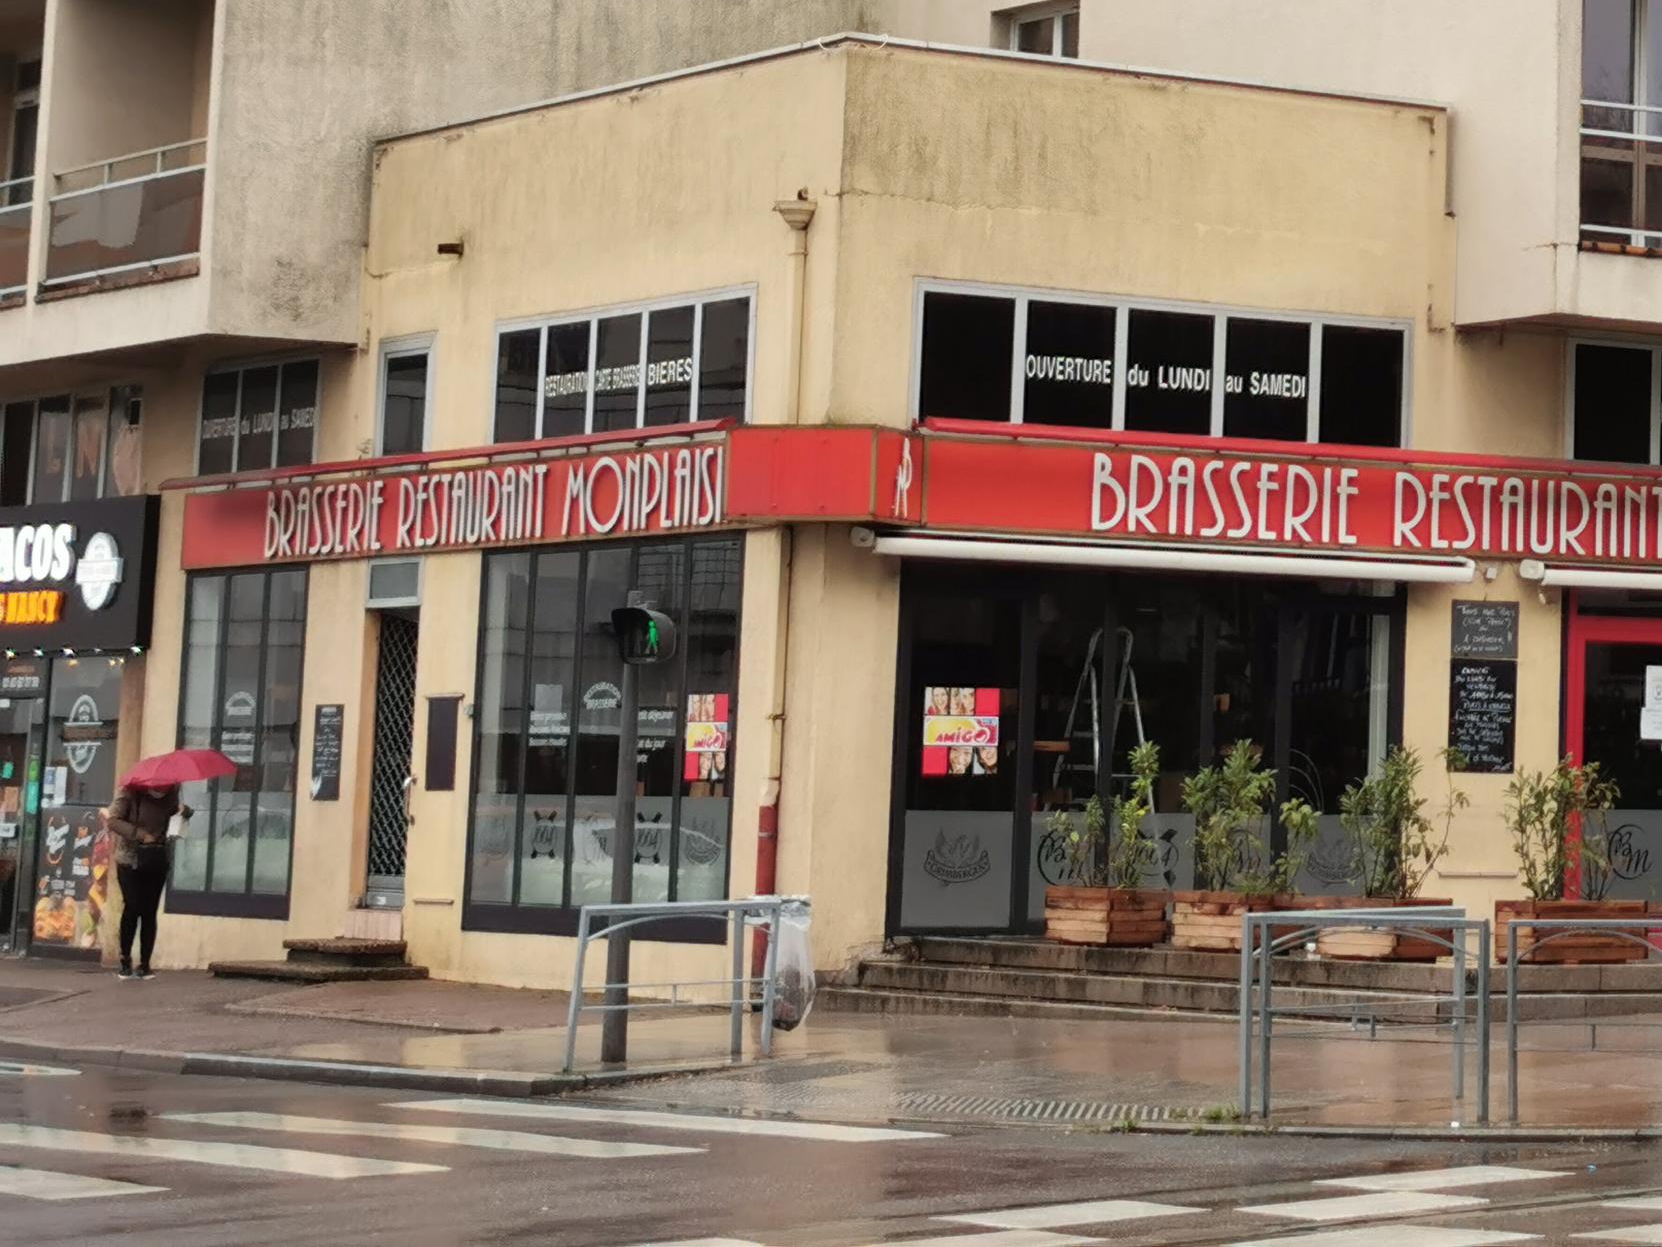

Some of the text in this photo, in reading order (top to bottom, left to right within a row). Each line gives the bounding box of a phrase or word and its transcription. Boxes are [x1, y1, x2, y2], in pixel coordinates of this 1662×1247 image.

[647, 357, 693, 386] BIERES
[1025, 354, 1306, 399] OUVERTURE du LUNDI au SAMEDI
[264, 446, 725, 559] BRASSERIE RESTAURANT MONPLAISI
[1091, 452, 1359, 545] BRASSERIE
